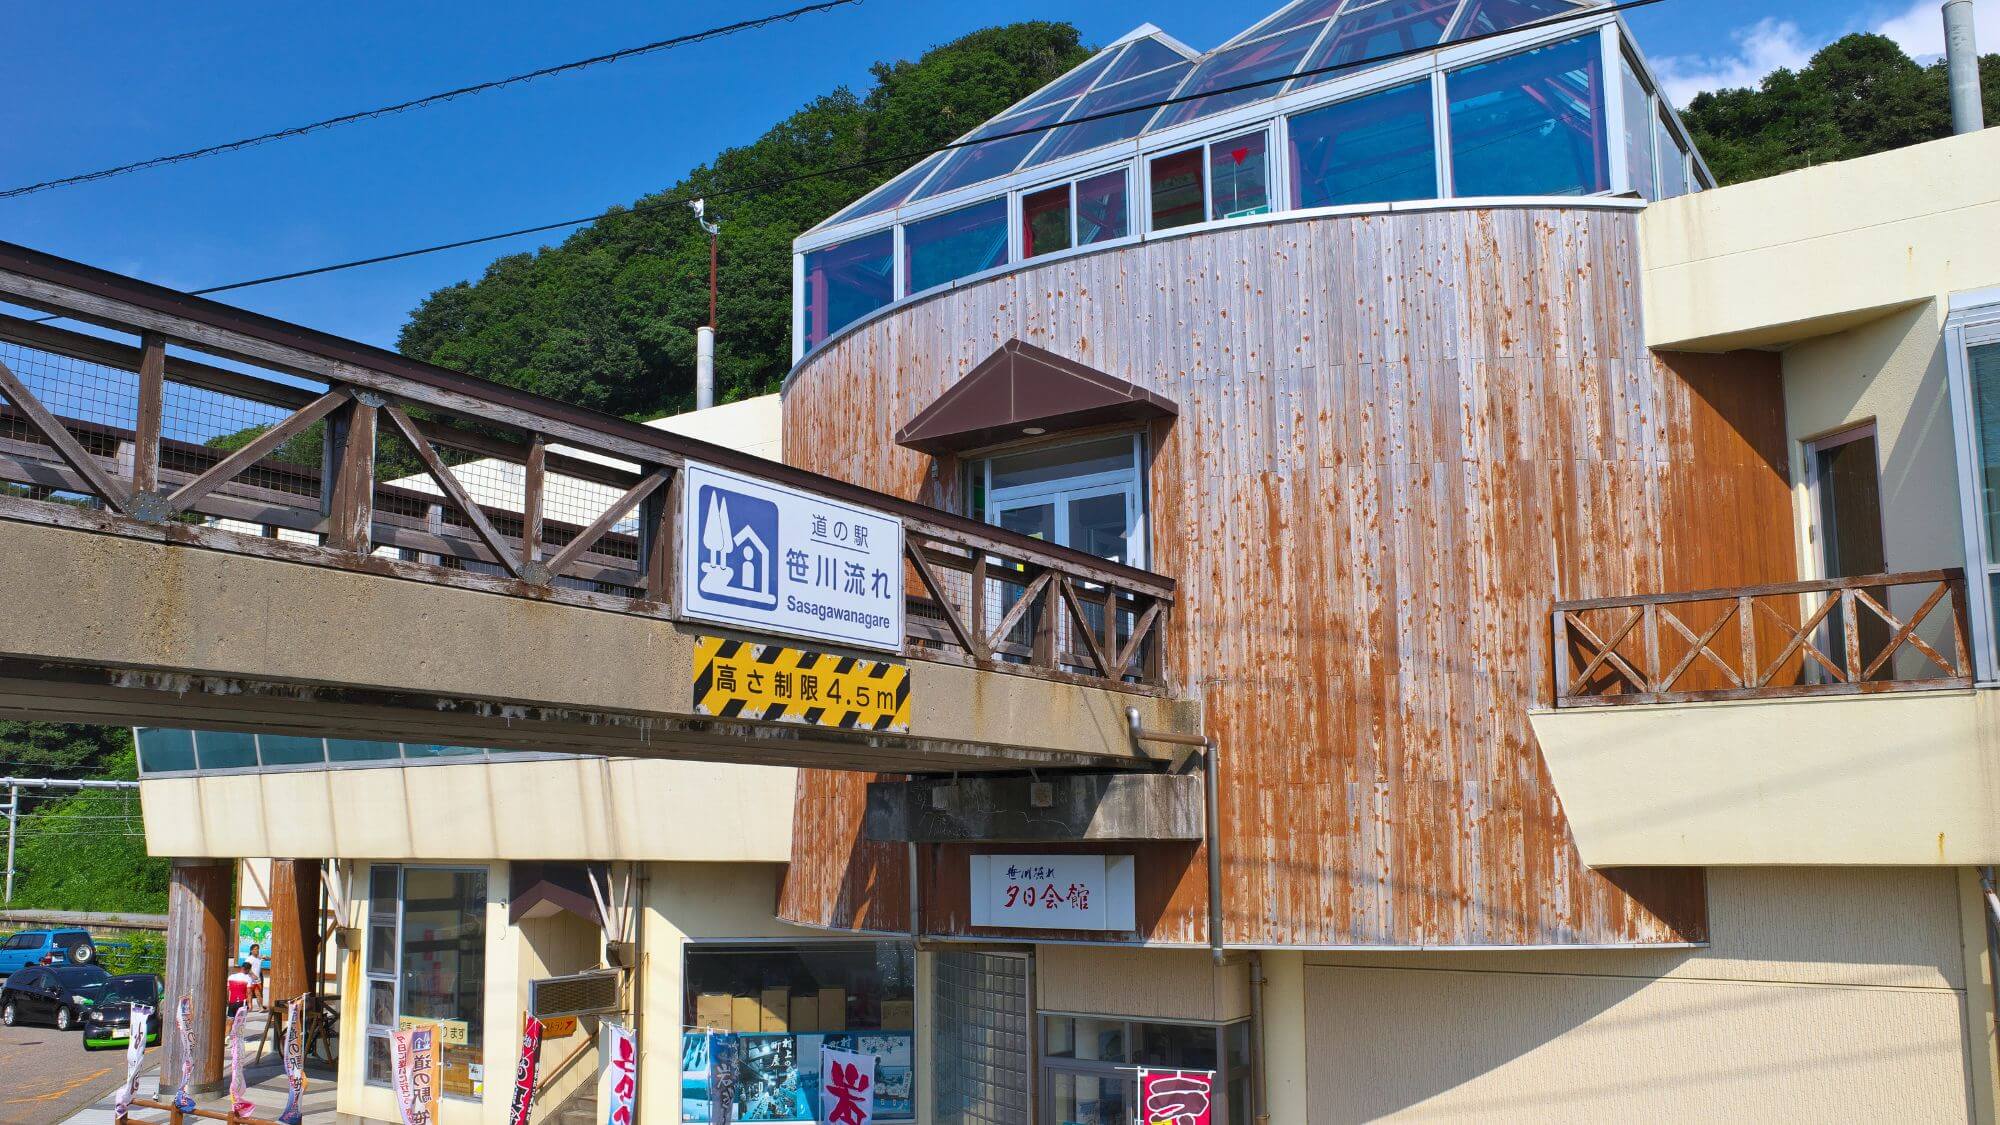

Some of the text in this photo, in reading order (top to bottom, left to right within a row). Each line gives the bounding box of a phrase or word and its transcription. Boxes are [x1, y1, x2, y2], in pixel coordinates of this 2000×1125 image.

[811, 513, 870, 548] 道の駅
[786, 547, 892, 600] 笹川流れ
[786, 595, 890, 630] Sasagawanagare
[1004, 883, 1090, 911] 夕日会館
